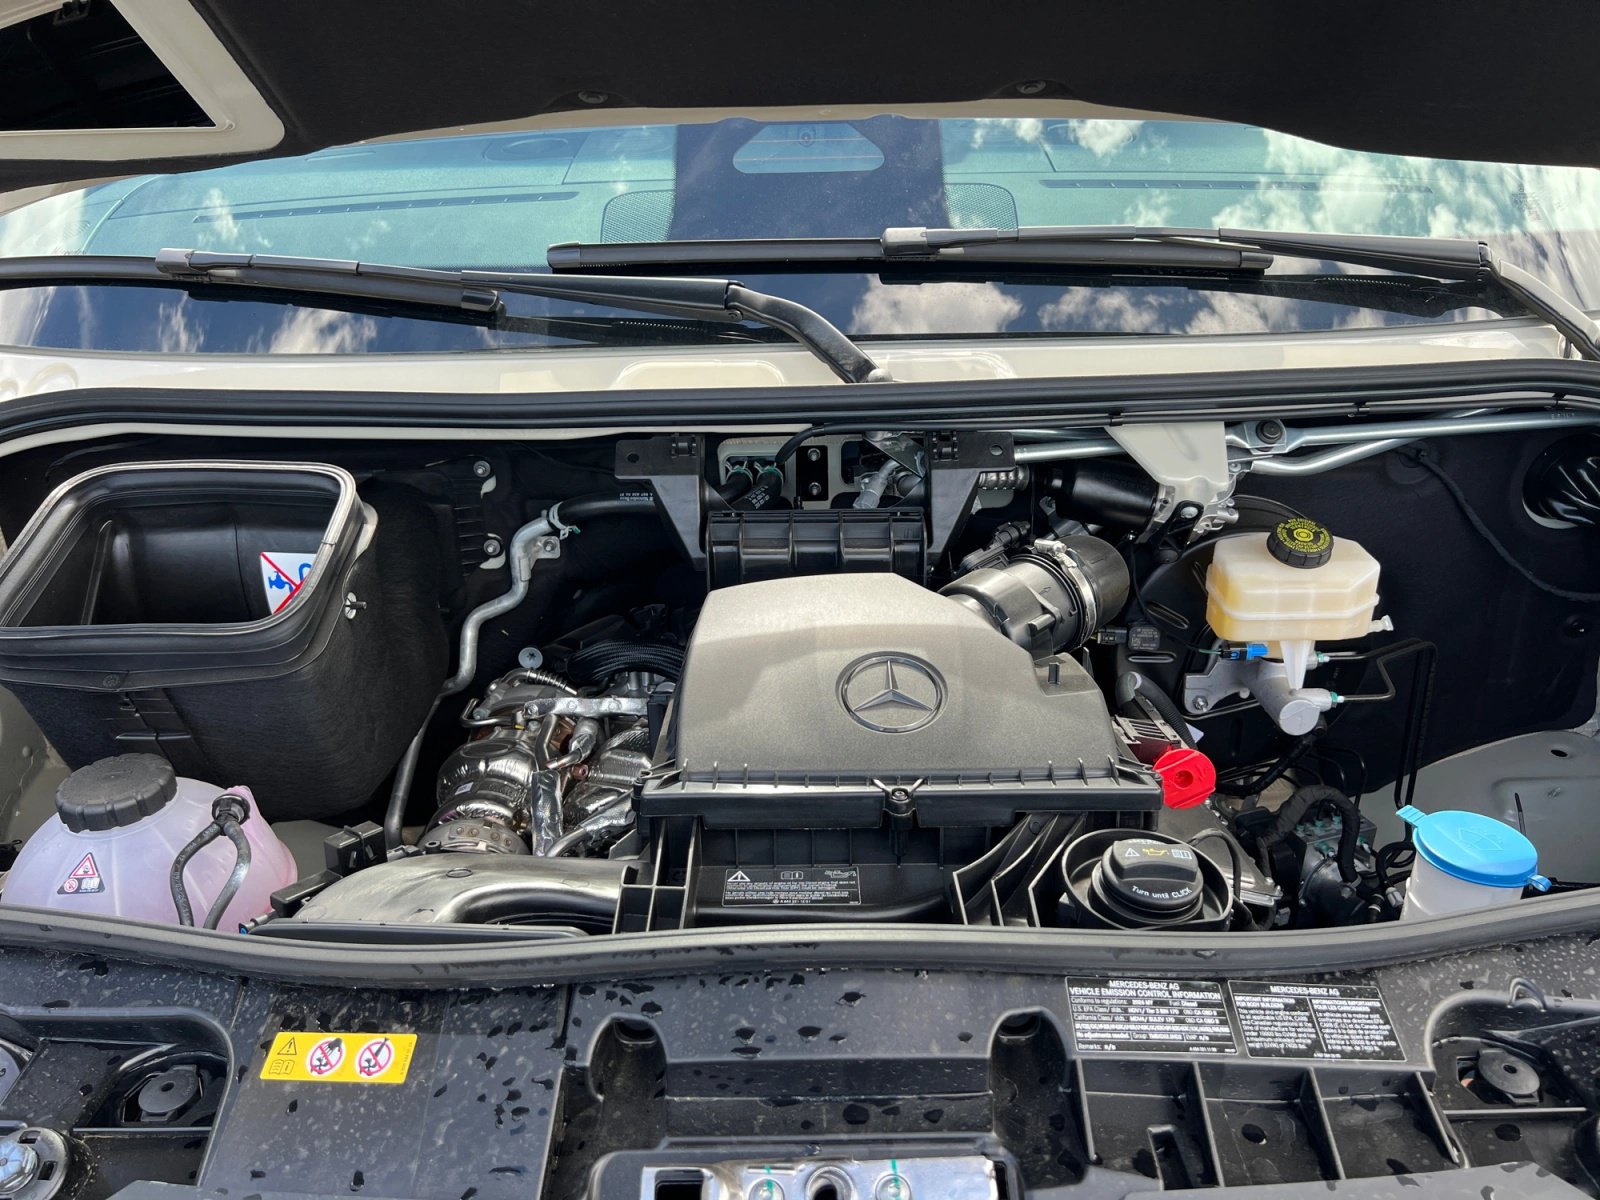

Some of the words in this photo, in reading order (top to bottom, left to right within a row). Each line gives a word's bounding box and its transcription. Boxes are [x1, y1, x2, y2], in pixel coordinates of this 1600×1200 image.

[1132, 885, 1150, 897] Turn
[1171, 887, 1193, 898] CLICK
[1109, 981, 1168, 990] MERCEDES-BENZ
[1269, 986, 1329, 995] MERCEDES-BENZ
[1069, 987, 1100, 995] VEHICLE
[1101, 989, 1136, 997] EMISSION
[1137, 990, 1172, 998] CONTROL
[1172, 992, 1221, 1000] INFORMATION
